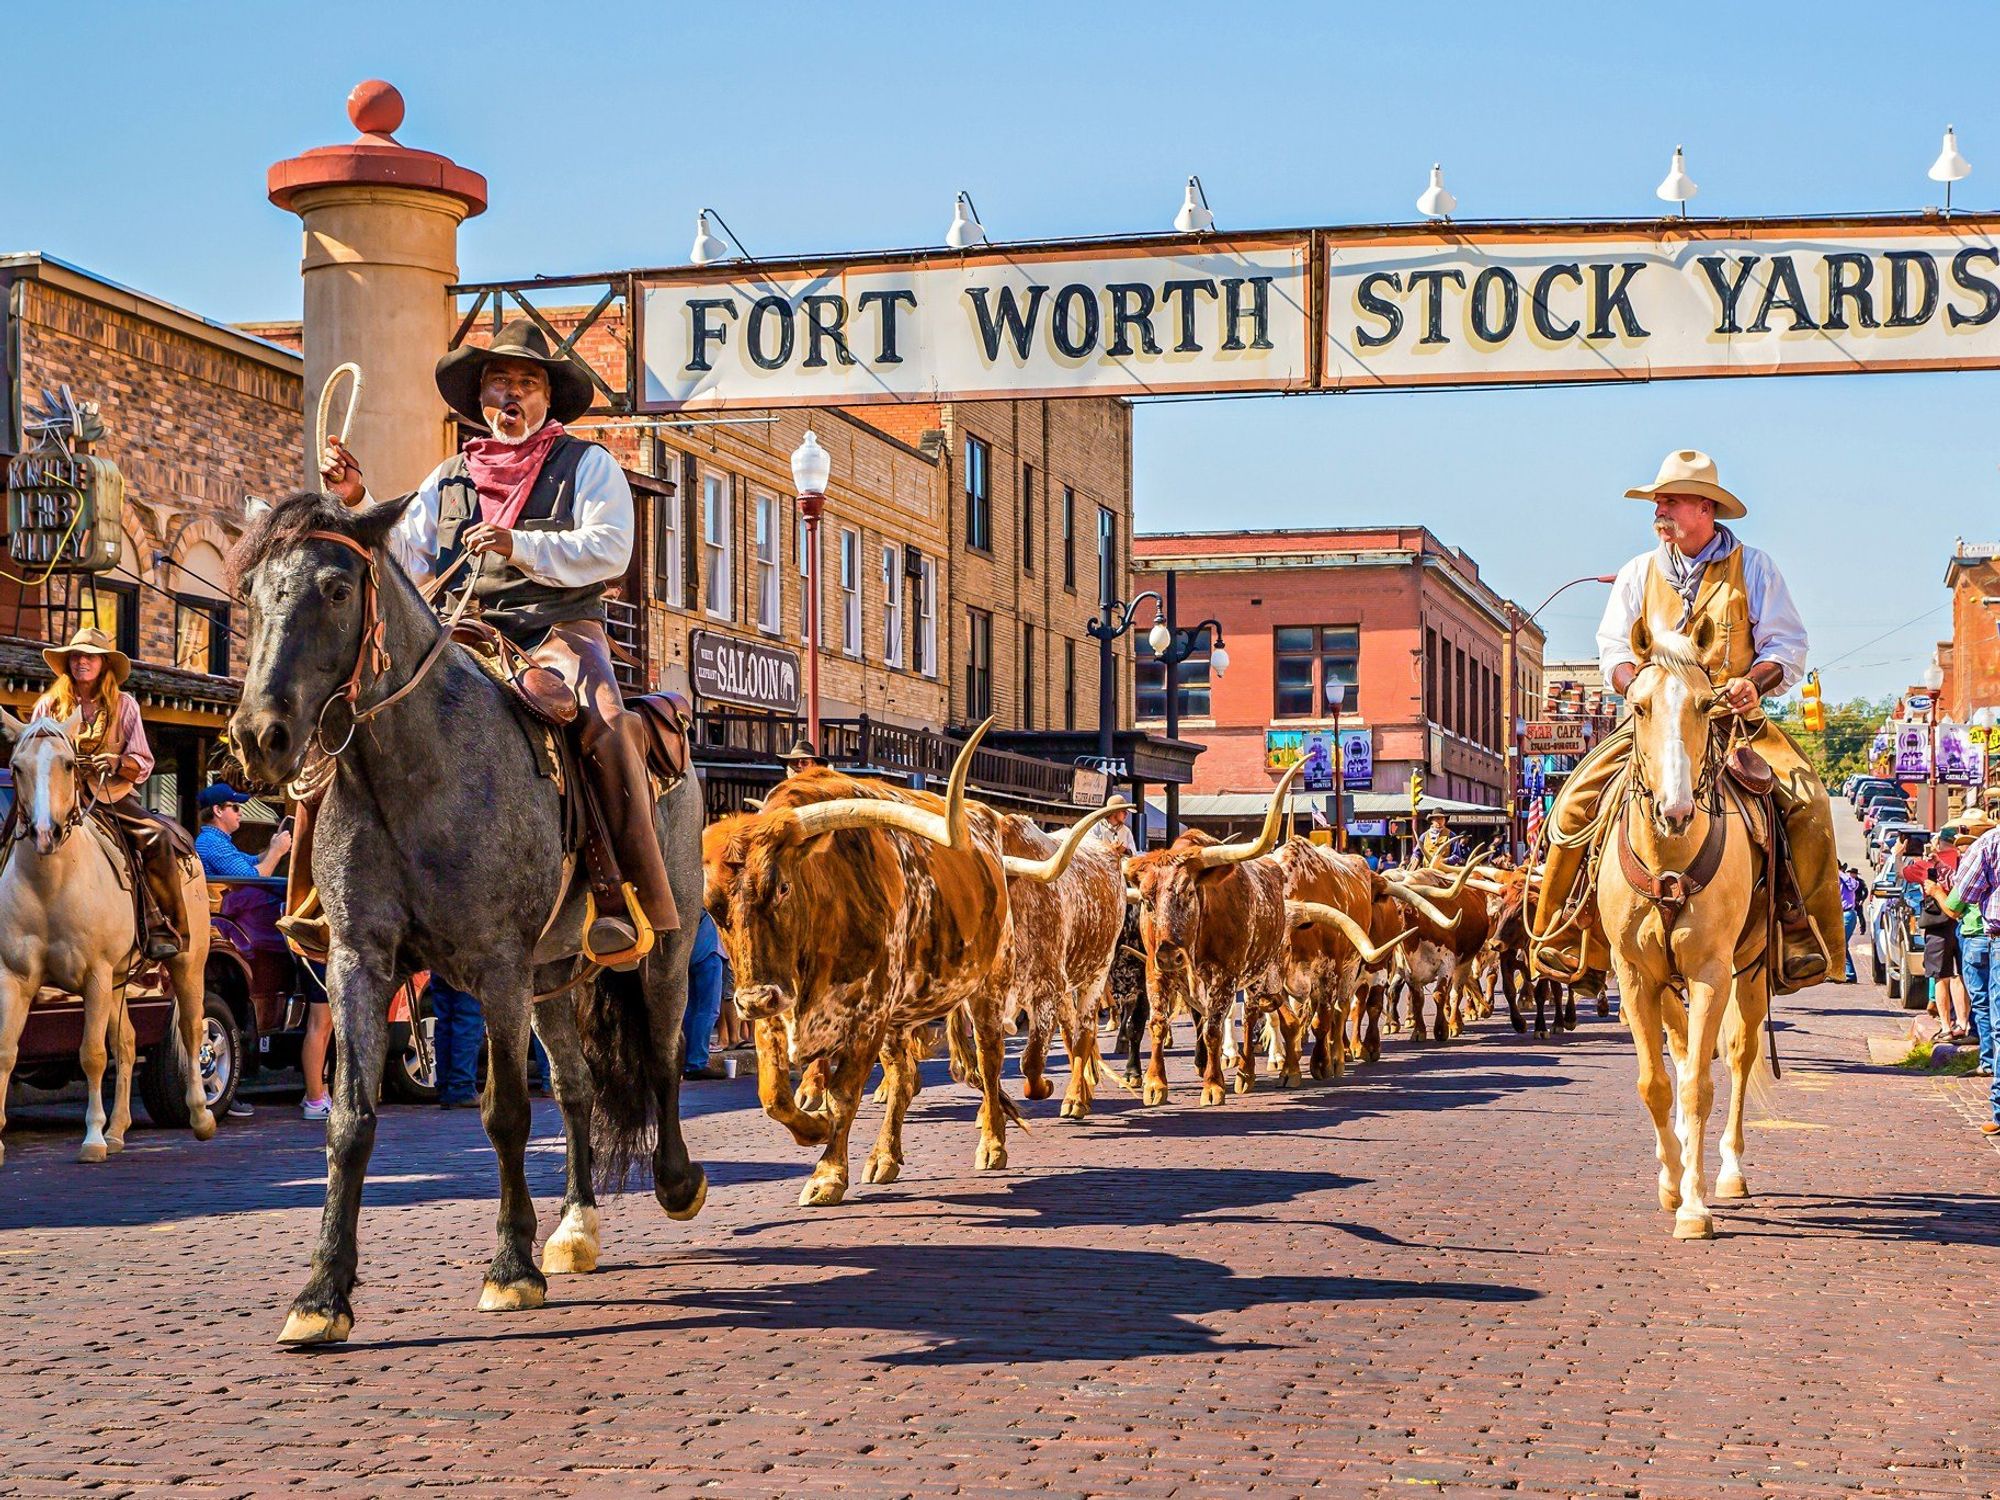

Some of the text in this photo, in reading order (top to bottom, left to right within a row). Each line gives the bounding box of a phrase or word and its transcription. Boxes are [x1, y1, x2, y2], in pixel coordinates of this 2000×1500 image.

[684, 246, 2000, 370] FORT WORTH STOCK YARDS
[11, 529, 91, 561] ALLEY
[717, 645, 779, 700] SALOON
[1526, 724, 1583, 738] STAR CAFE
[1347, 759, 1367, 767] AMP
